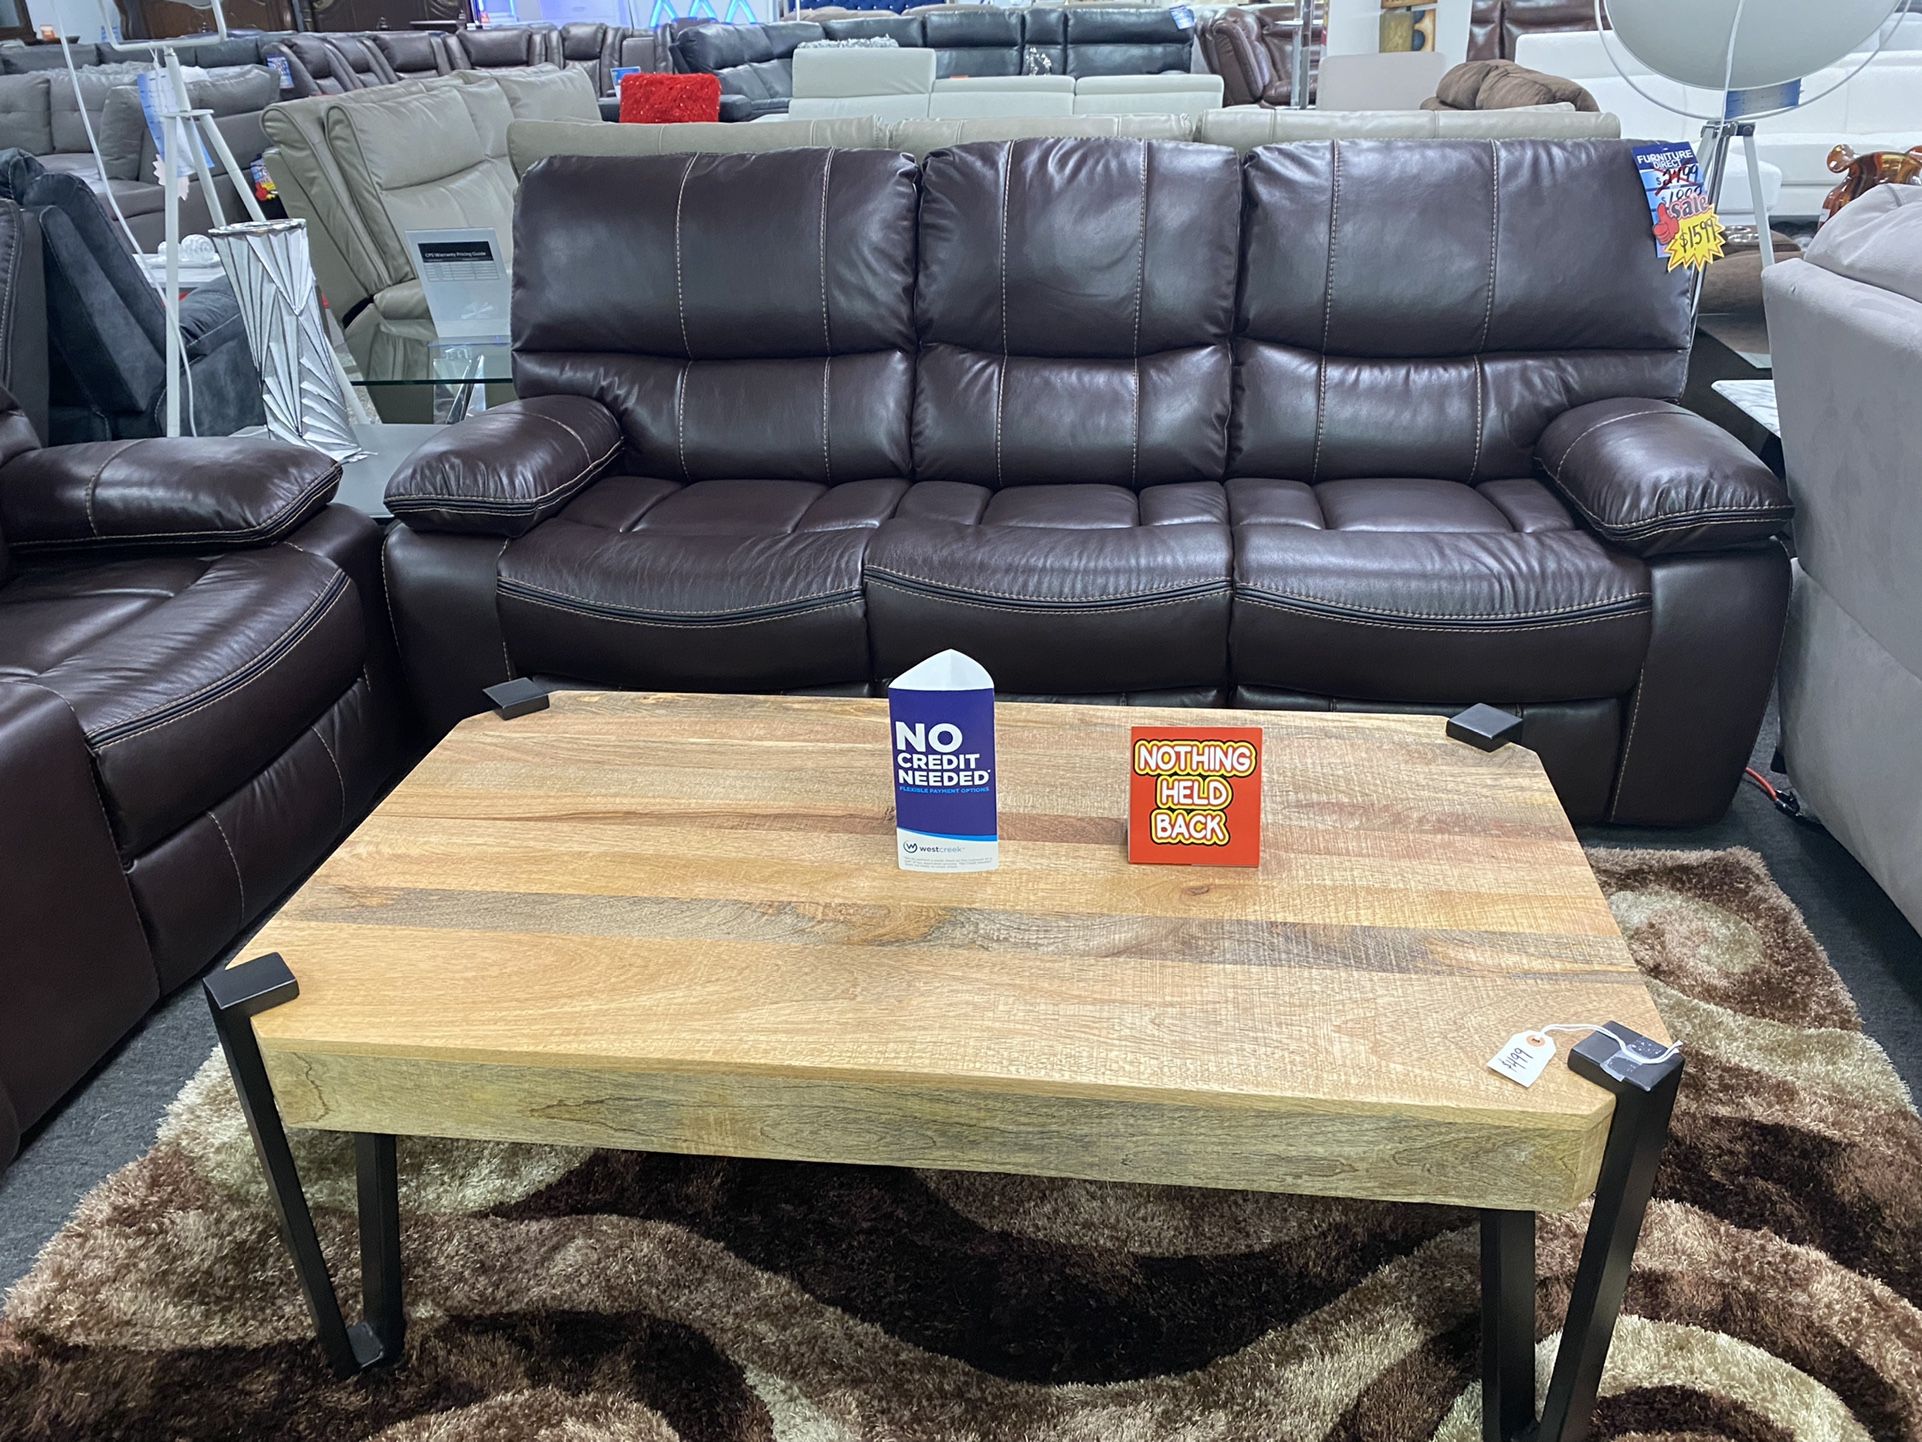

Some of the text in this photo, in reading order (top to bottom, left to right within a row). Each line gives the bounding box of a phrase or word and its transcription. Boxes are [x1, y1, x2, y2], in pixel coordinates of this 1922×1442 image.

[1637, 149, 1693, 164] FURNITURE
[1653, 159, 1681, 169] DIRECT
[1679, 218, 1716, 253] $1599
[895, 721, 963, 753] NO
[897, 752, 980, 770] CREDIT
[1137, 743, 1253, 773] NOTHING
[900, 786, 928, 794] FLEXIBLE
[1159, 778, 1229, 807] HELD
[1154, 812, 1226, 842] BACK
[1498, 1047, 1534, 1073] $499
